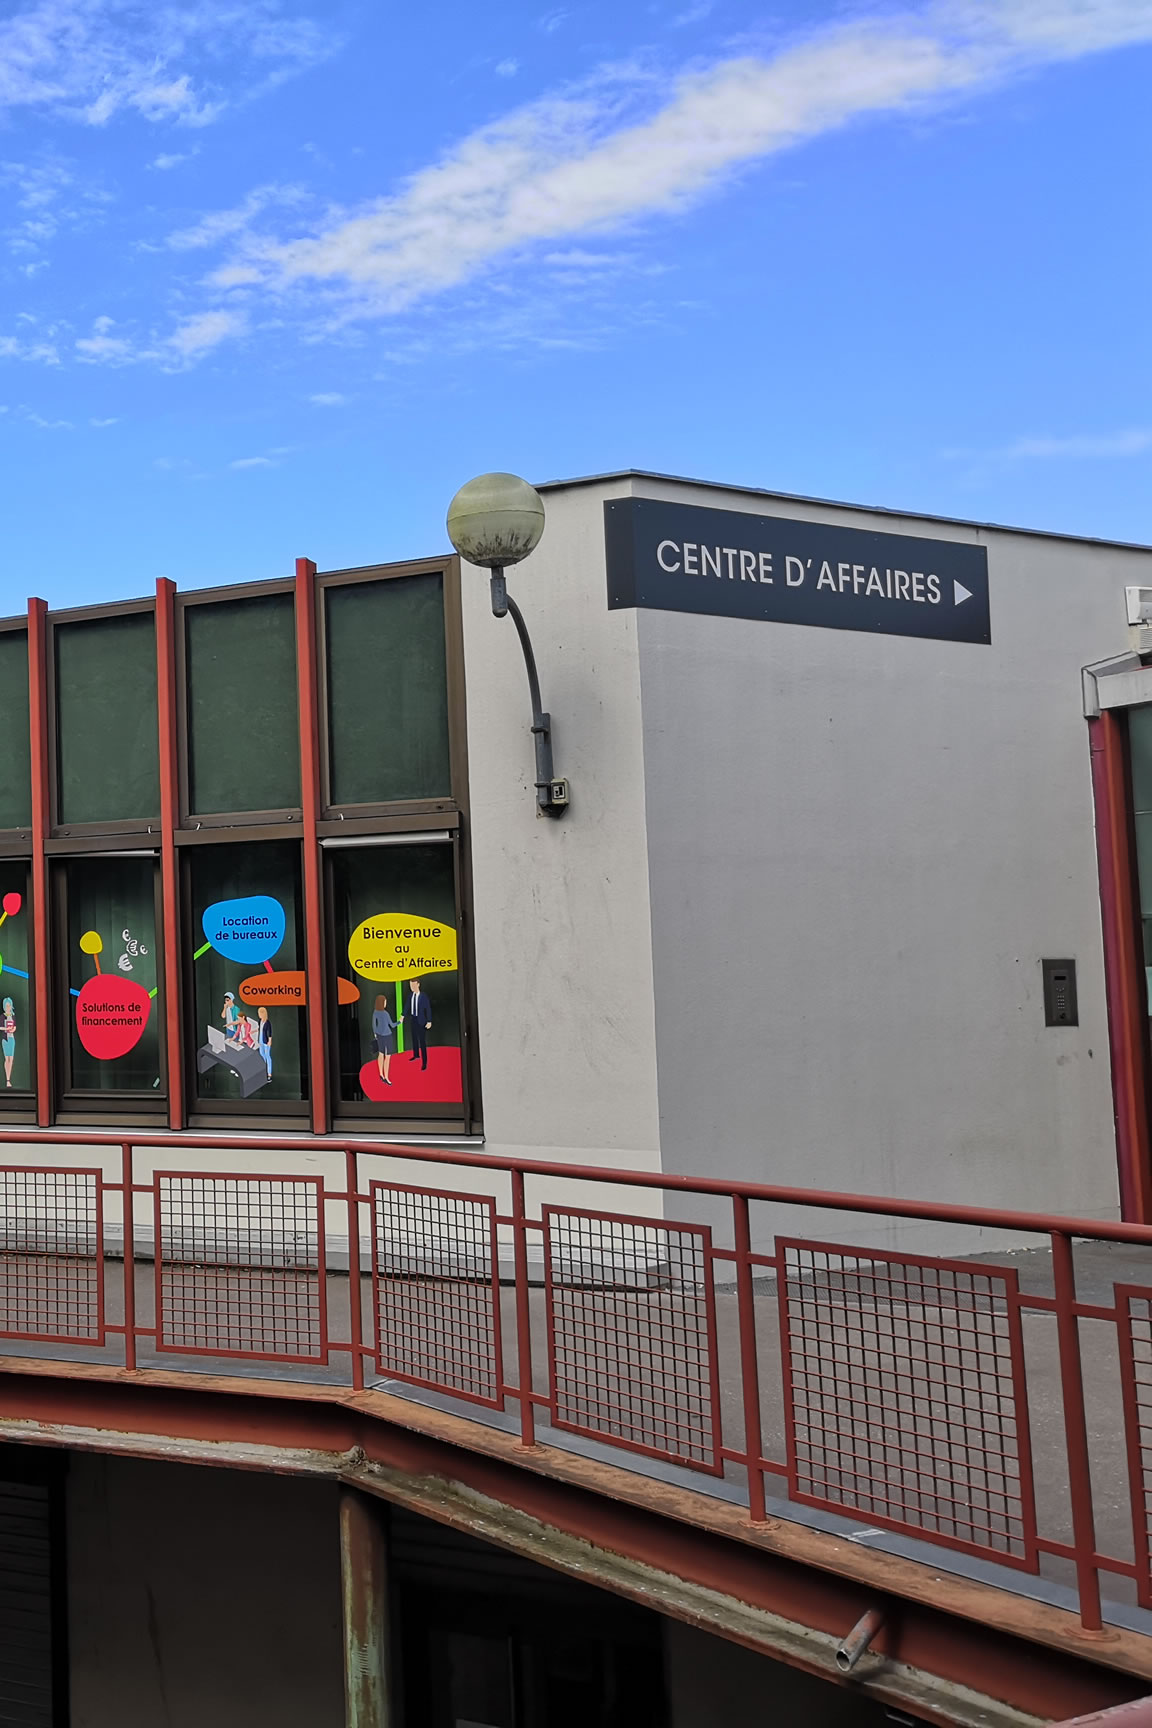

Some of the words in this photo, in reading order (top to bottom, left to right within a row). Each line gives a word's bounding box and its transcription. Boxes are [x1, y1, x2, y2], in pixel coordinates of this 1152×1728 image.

[656, 540, 774, 584] CENTRE
[785, 555, 942, 604] D'AFFAIRES
[223, 916, 269, 926] Location
[215, 931, 229, 940] de
[232, 931, 278, 940] bureaux
[363, 927, 441, 939] Bienvenue
[394, 945, 410, 953] au
[355, 958, 394, 969] Centre
[397, 957, 453, 968] d'Affaires
[242, 985, 302, 997] Coworking
[82, 1002, 125, 1012] Solutions
[128, 1002, 141, 1012] de
[82, 1016, 142, 1025] financement
